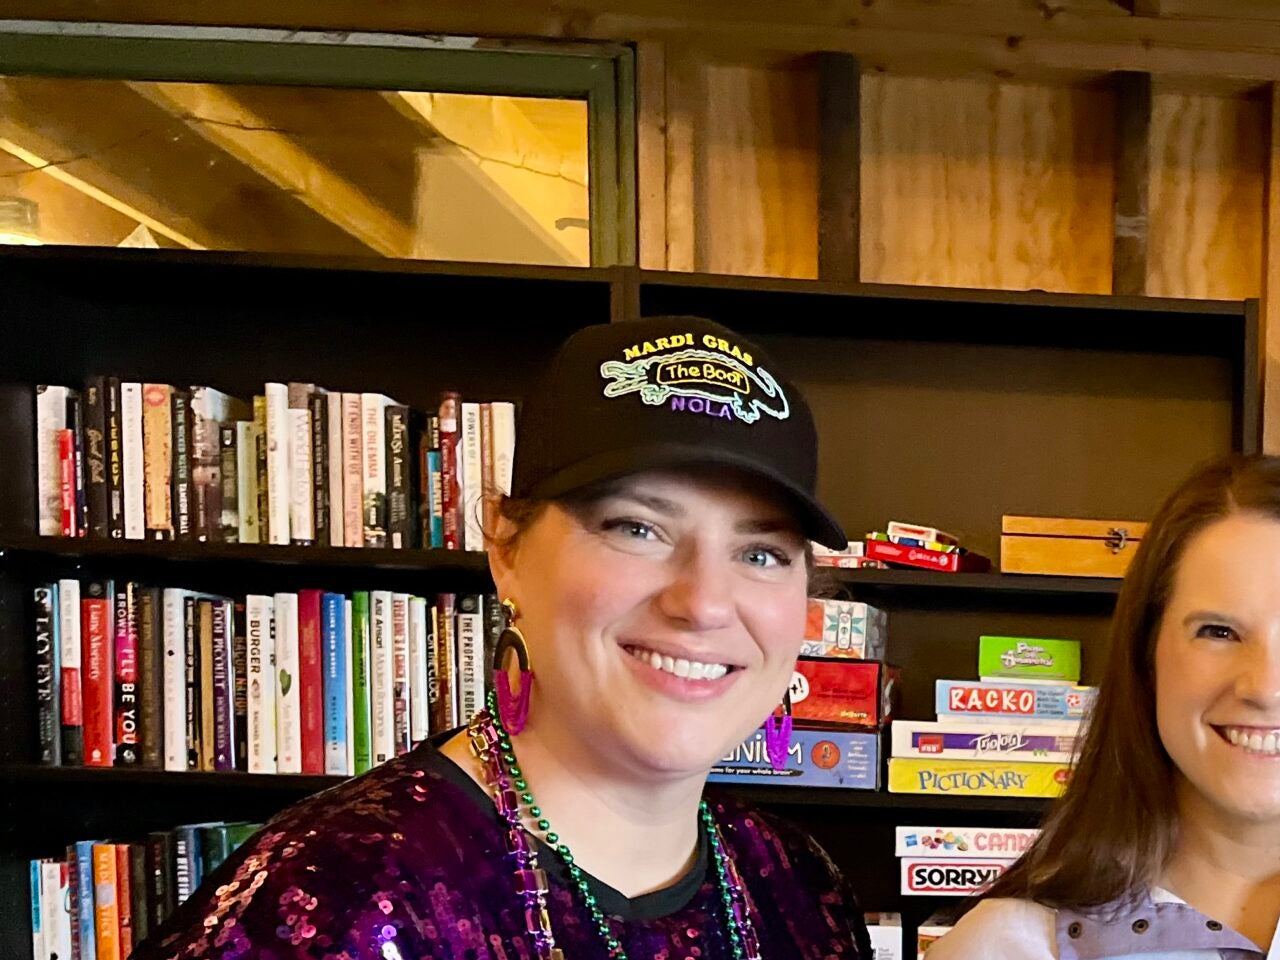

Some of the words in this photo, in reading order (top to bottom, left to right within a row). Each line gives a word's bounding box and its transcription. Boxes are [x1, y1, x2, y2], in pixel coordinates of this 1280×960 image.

[623, 333, 694, 361] MARDI
[703, 334, 753, 367] GRAS
[666, 364, 700, 380] The
[348, 400, 359, 410] IT
[367, 408, 376, 426] THE
[671, 397, 733, 420] NOLA
[348, 412, 360, 435] ENDS
[467, 412, 476, 447] POWERS
[111, 417, 119, 486] LEGACY
[349, 438, 360, 460] WITH
[367, 430, 378, 479] DILEMMA
[349, 463, 361, 475] US
[180, 515, 189, 534] HALL
[89, 604, 102, 632] Liane
[117, 593, 127, 638] BROWN
[213, 606, 225, 633] JODI
[375, 598, 383, 616] Aziz
[375, 618, 384, 649] Ansari
[462, 617, 472, 633] THE
[88, 635, 103, 680] Moriarty
[235, 636, 247, 674] BACON
[250, 620, 261, 674] BURGER
[463, 636, 474, 683] PROPHETS
[121, 648, 134, 677] I'LL
[214, 638, 226, 691] PICOULT
[122, 683, 135, 703] BE
[235, 677, 247, 716] NATION
[122, 709, 136, 744] YOU
[918, 768, 1031, 791] PICTIONARY
[974, 833, 1036, 852] CAND
[915, 868, 998, 886] SORRY!
